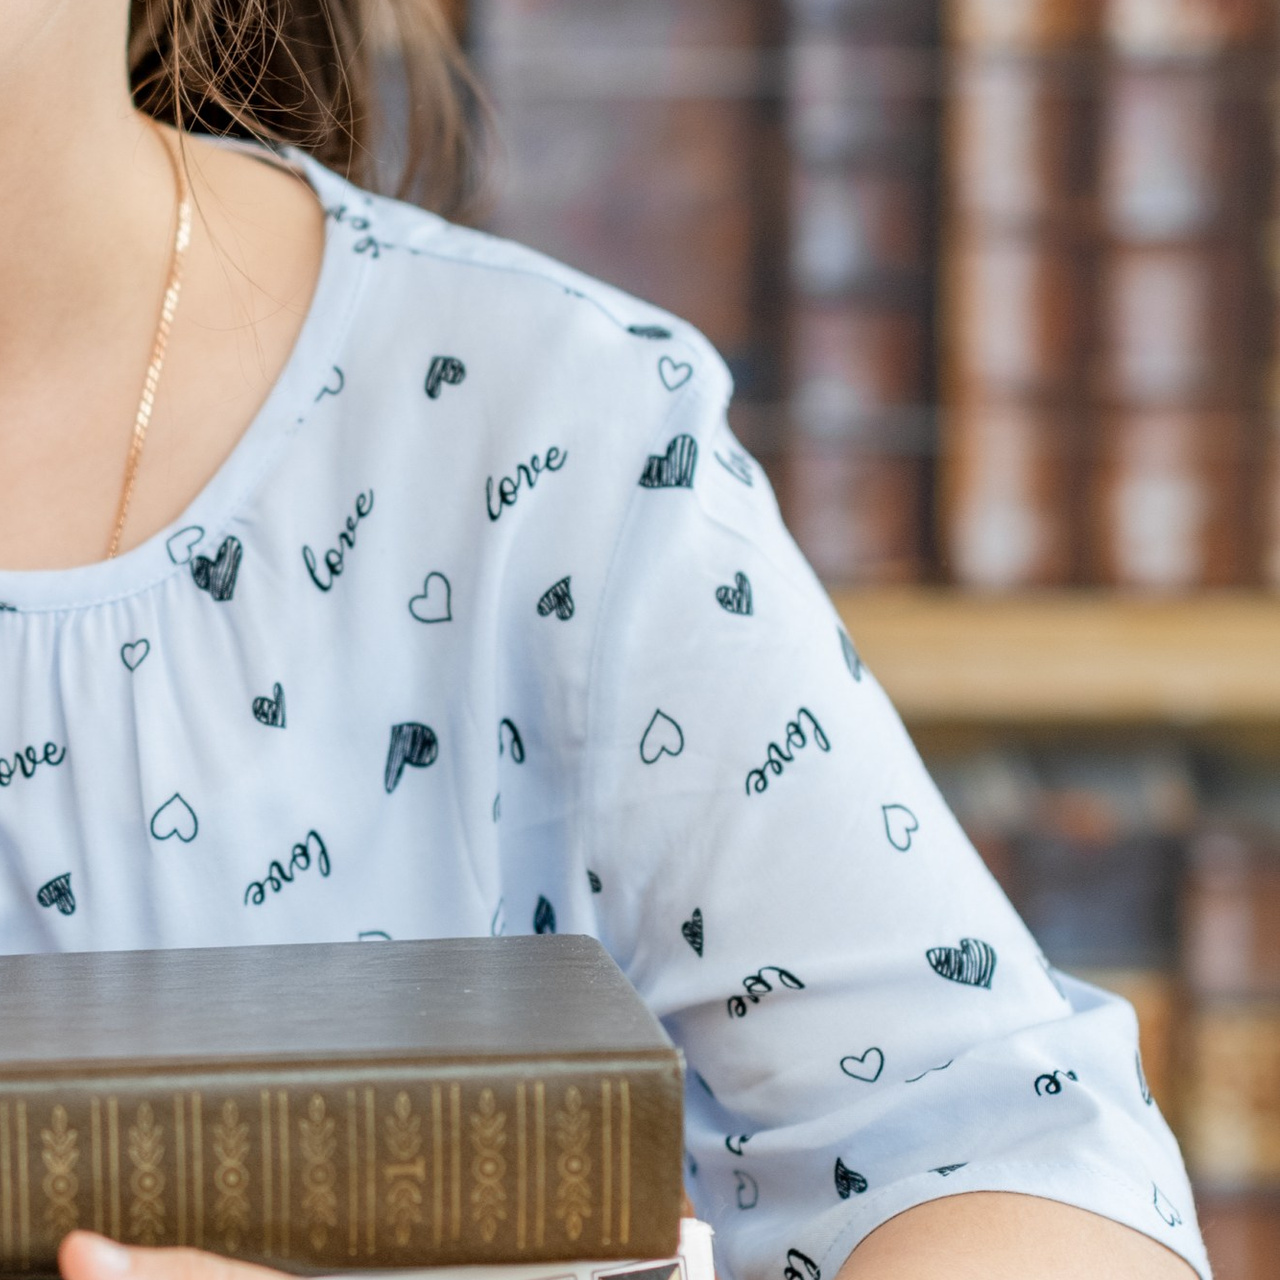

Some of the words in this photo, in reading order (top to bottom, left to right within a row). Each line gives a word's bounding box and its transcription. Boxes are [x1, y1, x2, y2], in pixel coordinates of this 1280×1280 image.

[485, 446, 568, 522] love
[302, 489, 375, 593] love
[745, 706, 831, 797] love
[244, 829, 331, 907] love
